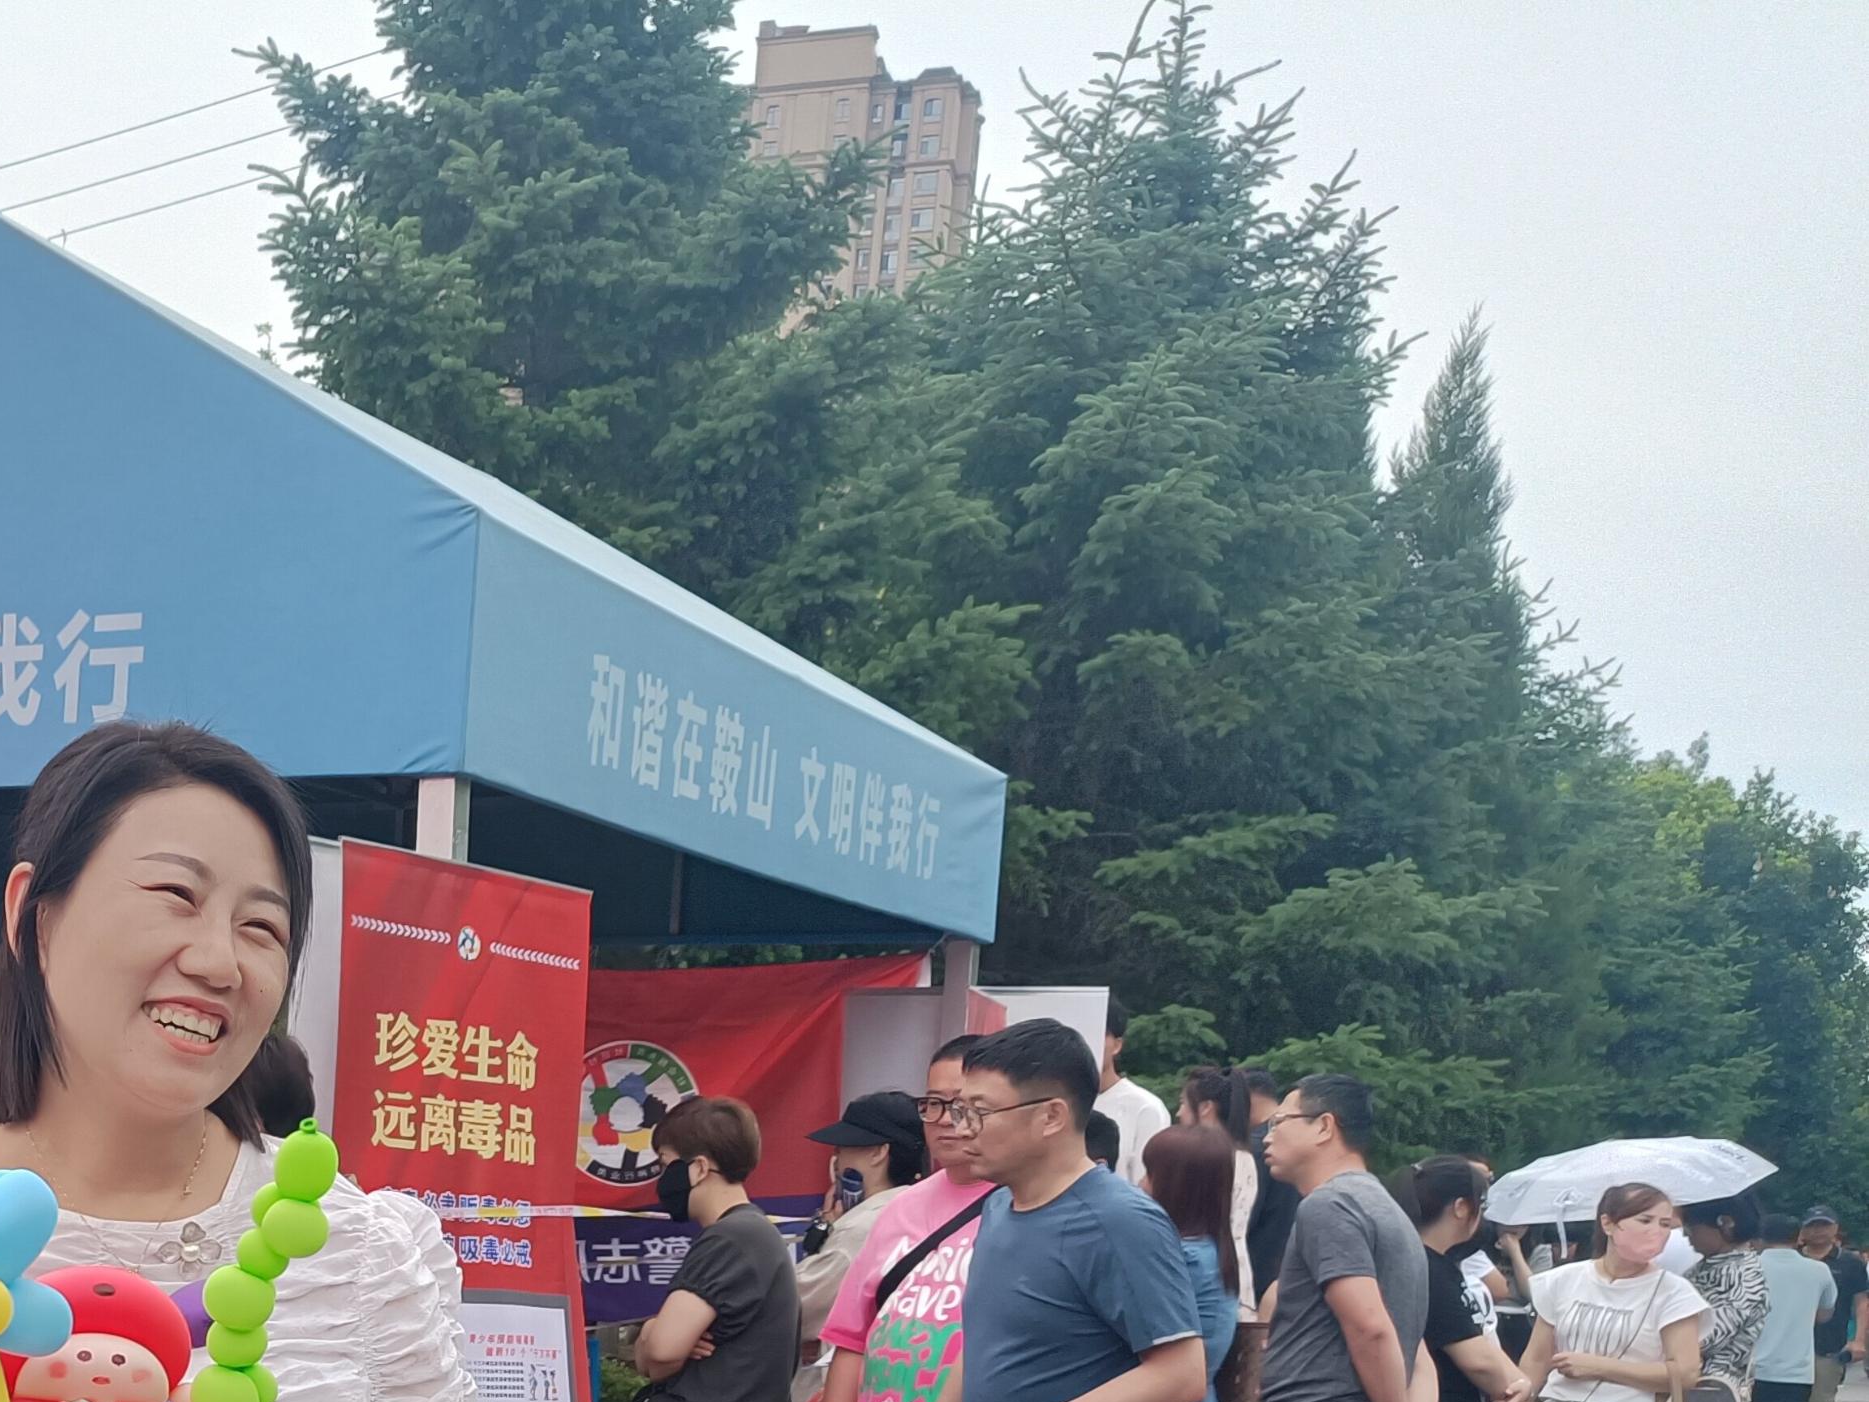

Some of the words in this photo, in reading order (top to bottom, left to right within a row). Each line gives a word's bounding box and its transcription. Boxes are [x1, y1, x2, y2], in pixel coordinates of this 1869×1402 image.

[587, 654, 778, 832] 和谐在鞍山
[794, 745, 942, 881] 文明伴我行
[373, 1010, 539, 1093] 珍爱生命
[371, 1089, 537, 1167] 远离毒品
